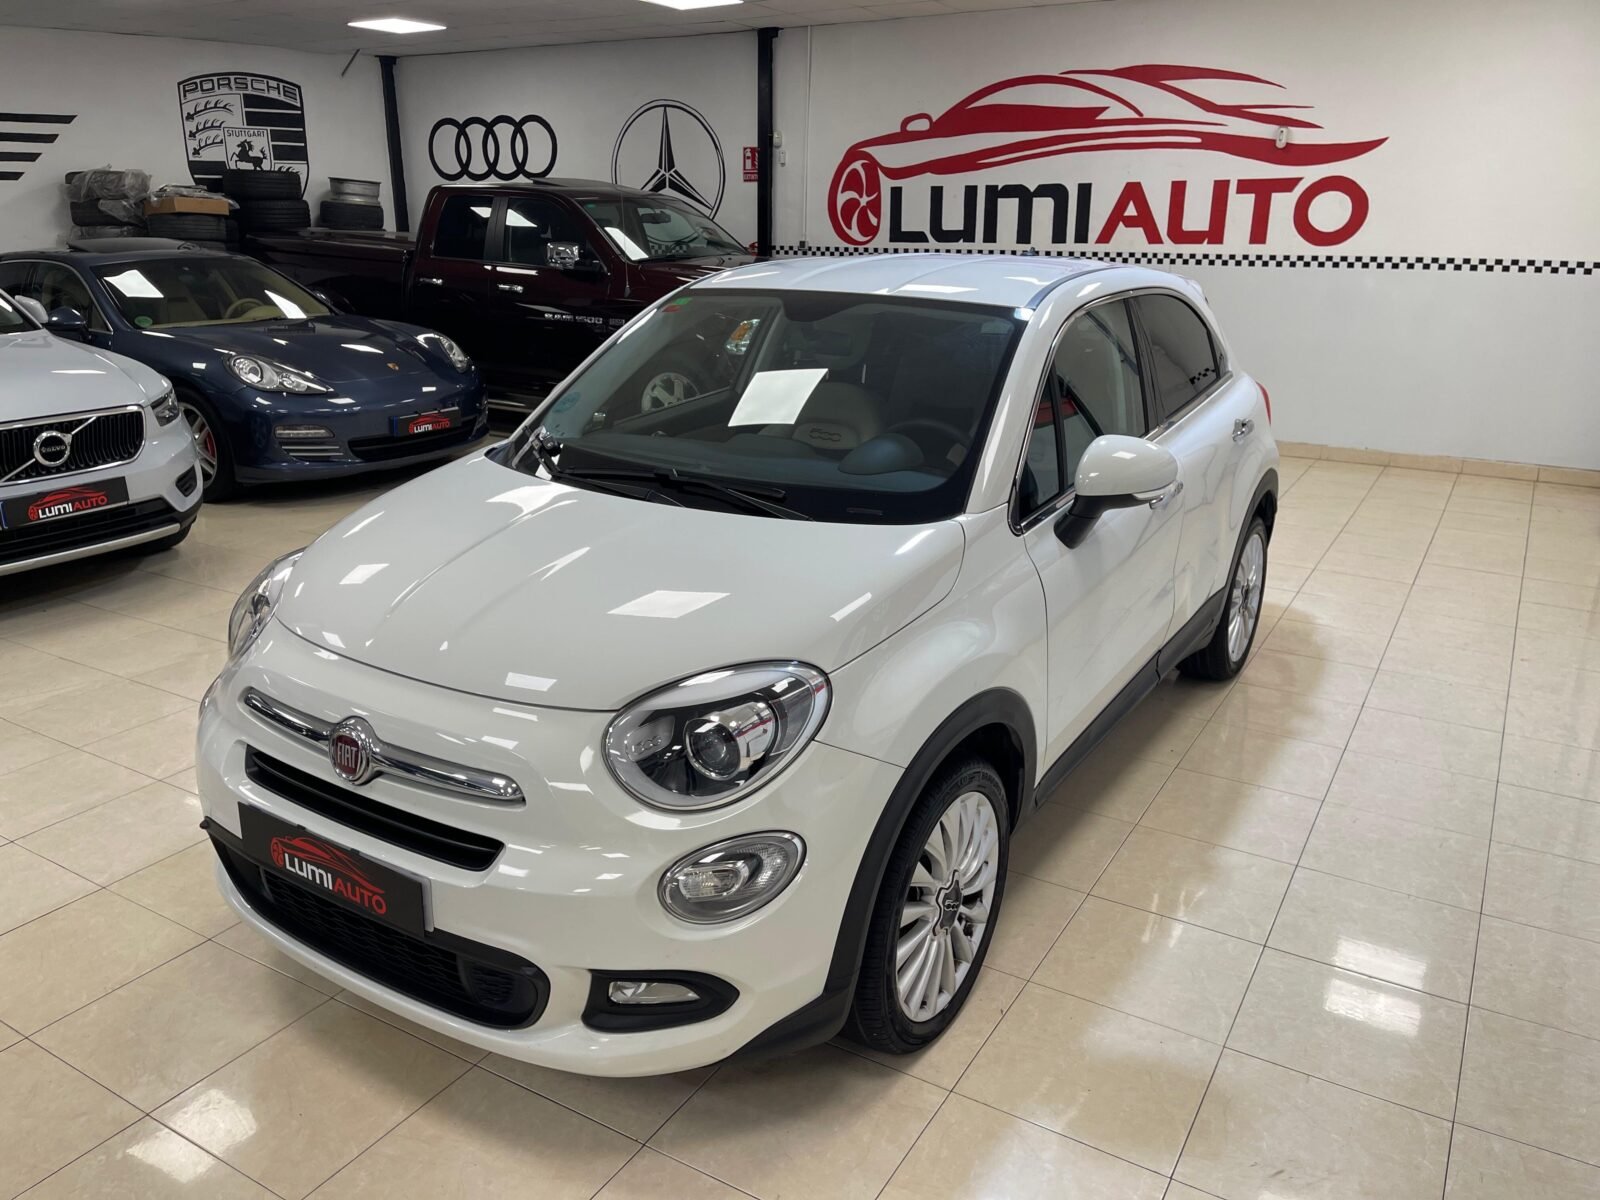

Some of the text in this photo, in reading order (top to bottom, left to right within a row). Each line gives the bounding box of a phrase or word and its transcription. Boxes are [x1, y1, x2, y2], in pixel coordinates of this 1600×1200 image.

[183, 77, 298, 102] PORSCHE
[226, 129, 266, 139] STUTTGART
[41, 445, 66, 454] VOLVO
[337, 742, 359, 769] FIAT
